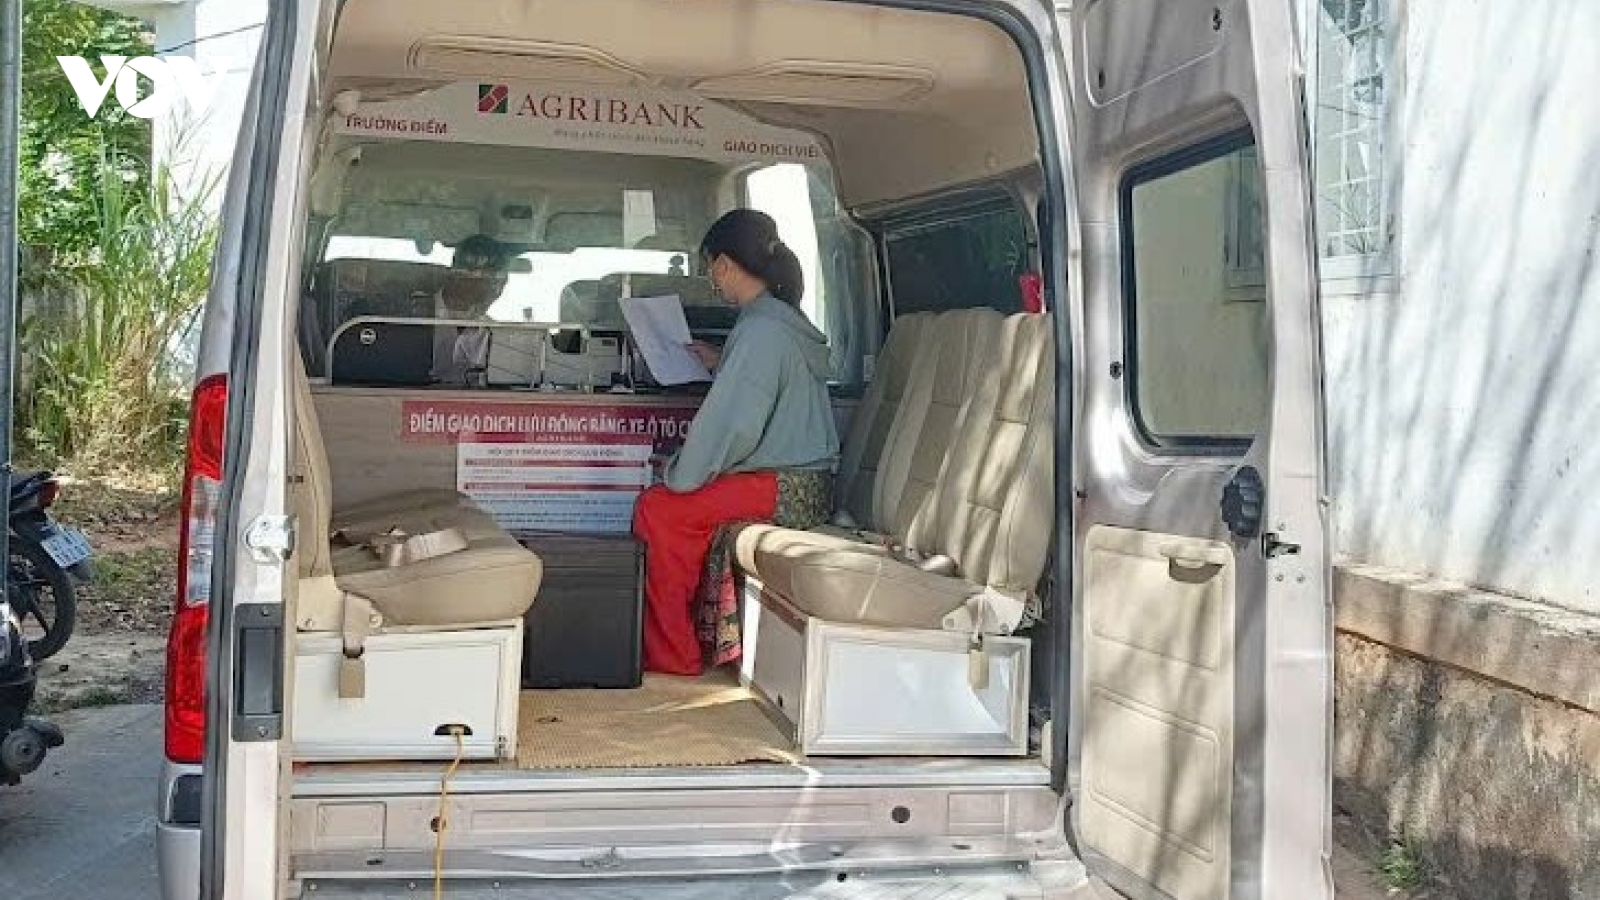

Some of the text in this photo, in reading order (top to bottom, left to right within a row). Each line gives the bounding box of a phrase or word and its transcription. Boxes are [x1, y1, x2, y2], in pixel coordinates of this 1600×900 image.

[516, 92, 704, 130] AGRIBANK
[722, 138, 757, 154] GIAO
[410, 407, 445, 433] ĐIỂM
[448, 413, 480, 433] GIAO
[629, 417, 645, 435] XE
